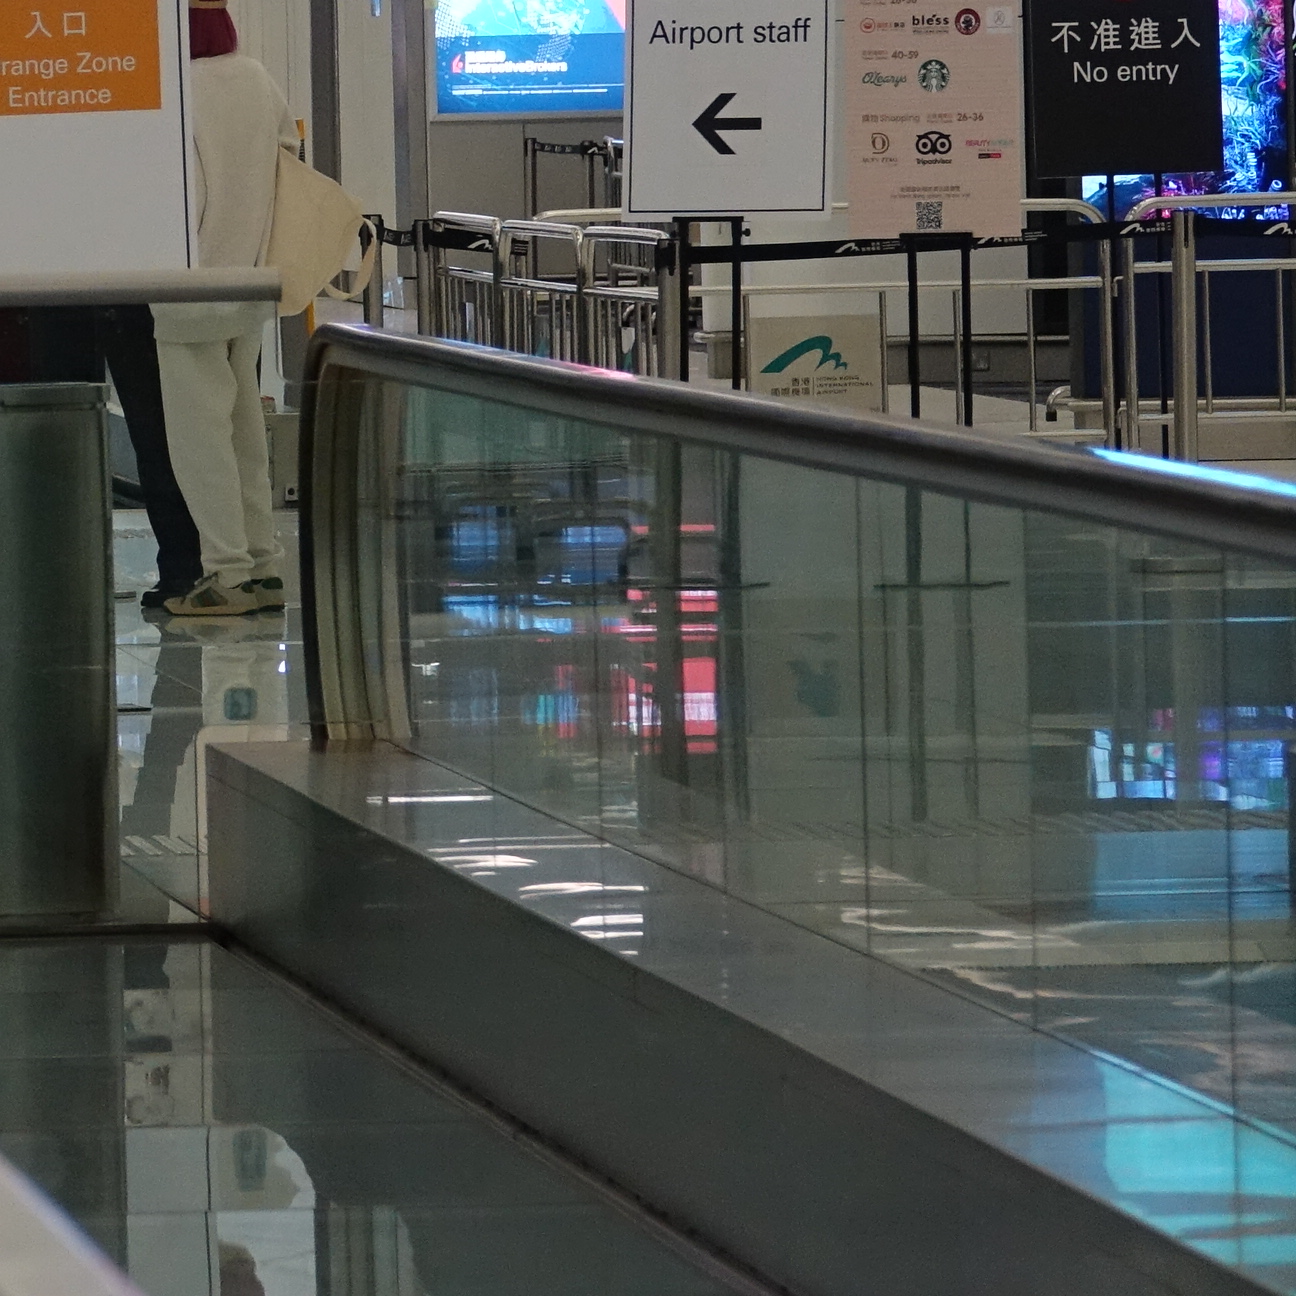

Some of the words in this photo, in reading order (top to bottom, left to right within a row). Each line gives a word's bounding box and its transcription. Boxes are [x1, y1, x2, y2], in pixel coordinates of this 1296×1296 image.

[24, 11, 87, 38] 入口
[649, 20, 744, 50] Airport
[754, 18, 811, 43] staff
[1051, 17, 1201, 54] 不准進入
[77, 52, 136, 73] Zone
[891, 50, 919, 59] 40-59
[1074, 61, 1107, 82] No
[1117, 61, 1179, 85] entry
[8, 85, 112, 108] Entrance
[880, 113, 921, 124] Shopping
[957, 112, 984, 122] 26-36
